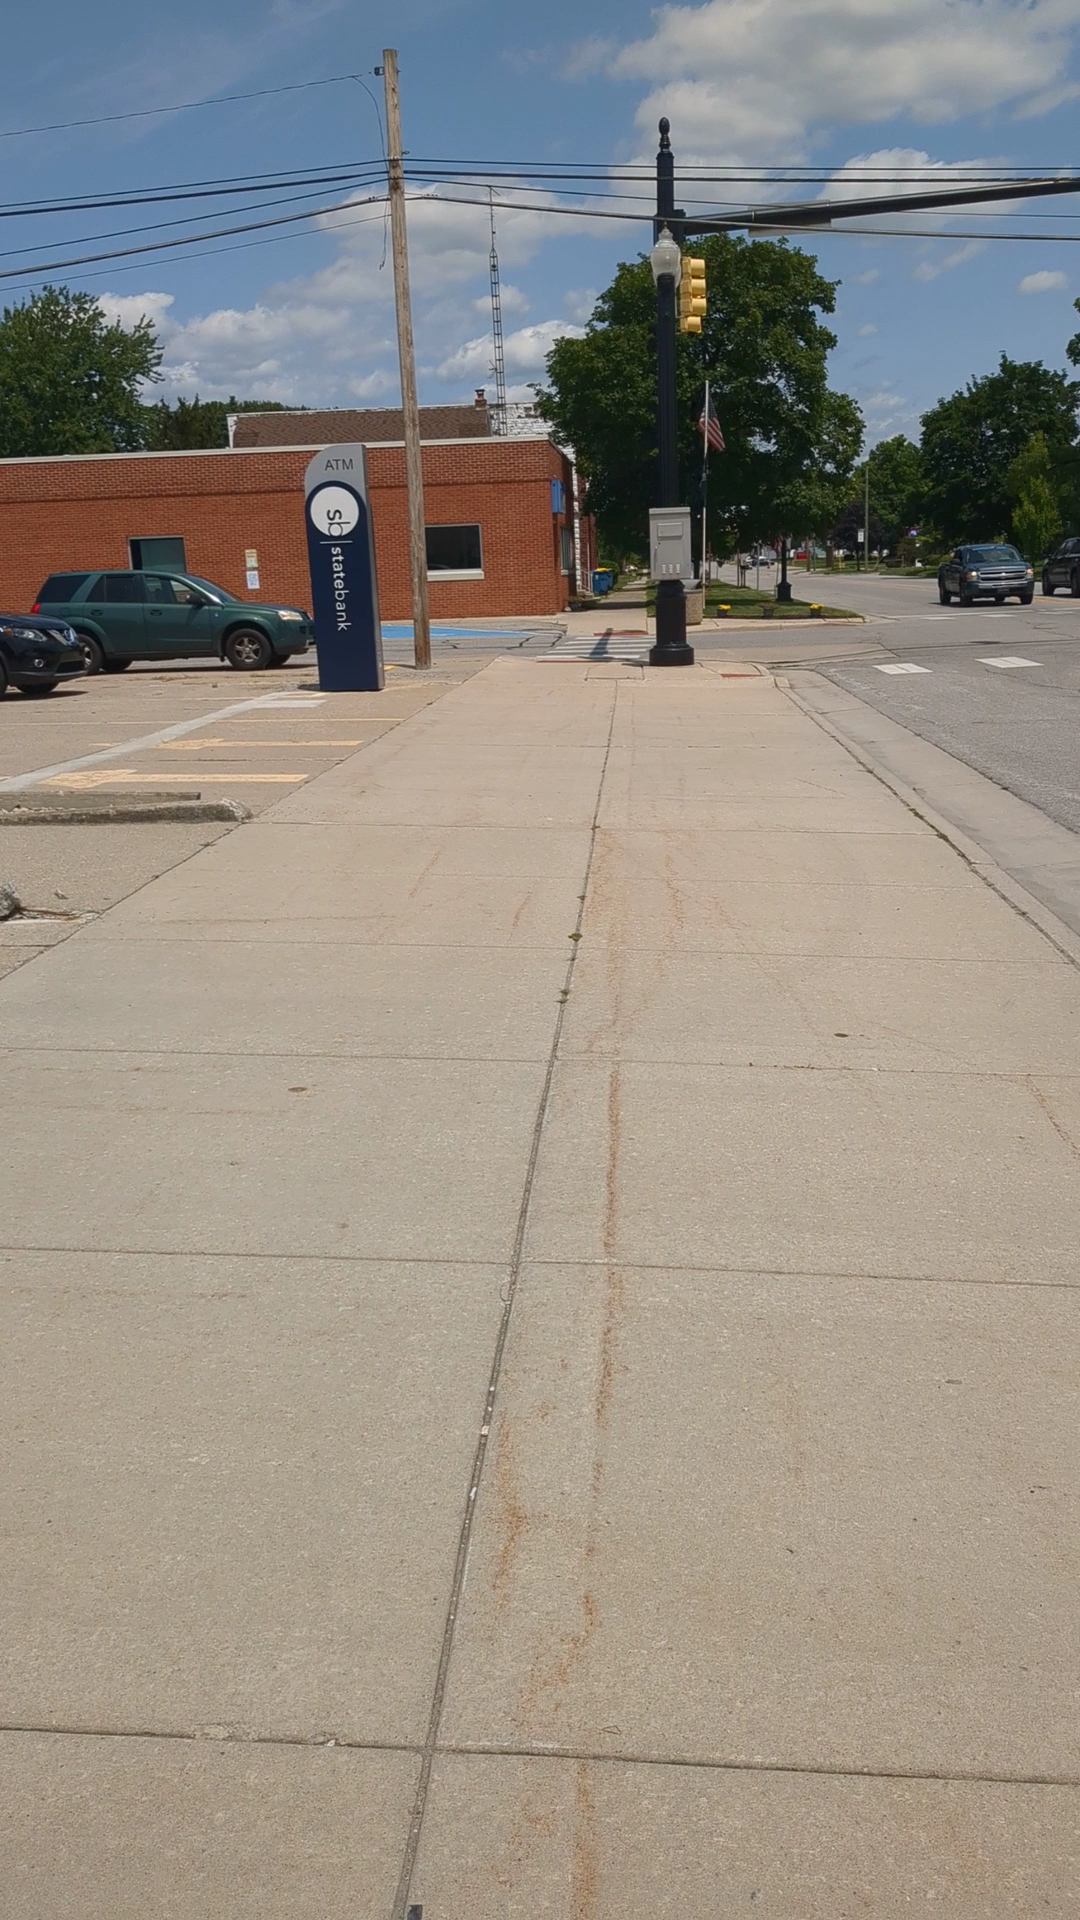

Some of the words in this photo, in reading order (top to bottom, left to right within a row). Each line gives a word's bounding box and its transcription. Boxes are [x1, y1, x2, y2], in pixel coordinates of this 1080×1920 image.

[325, 459, 354, 471] ATM
[327, 509, 351, 536] sb
[331, 547, 352, 631] statebank
